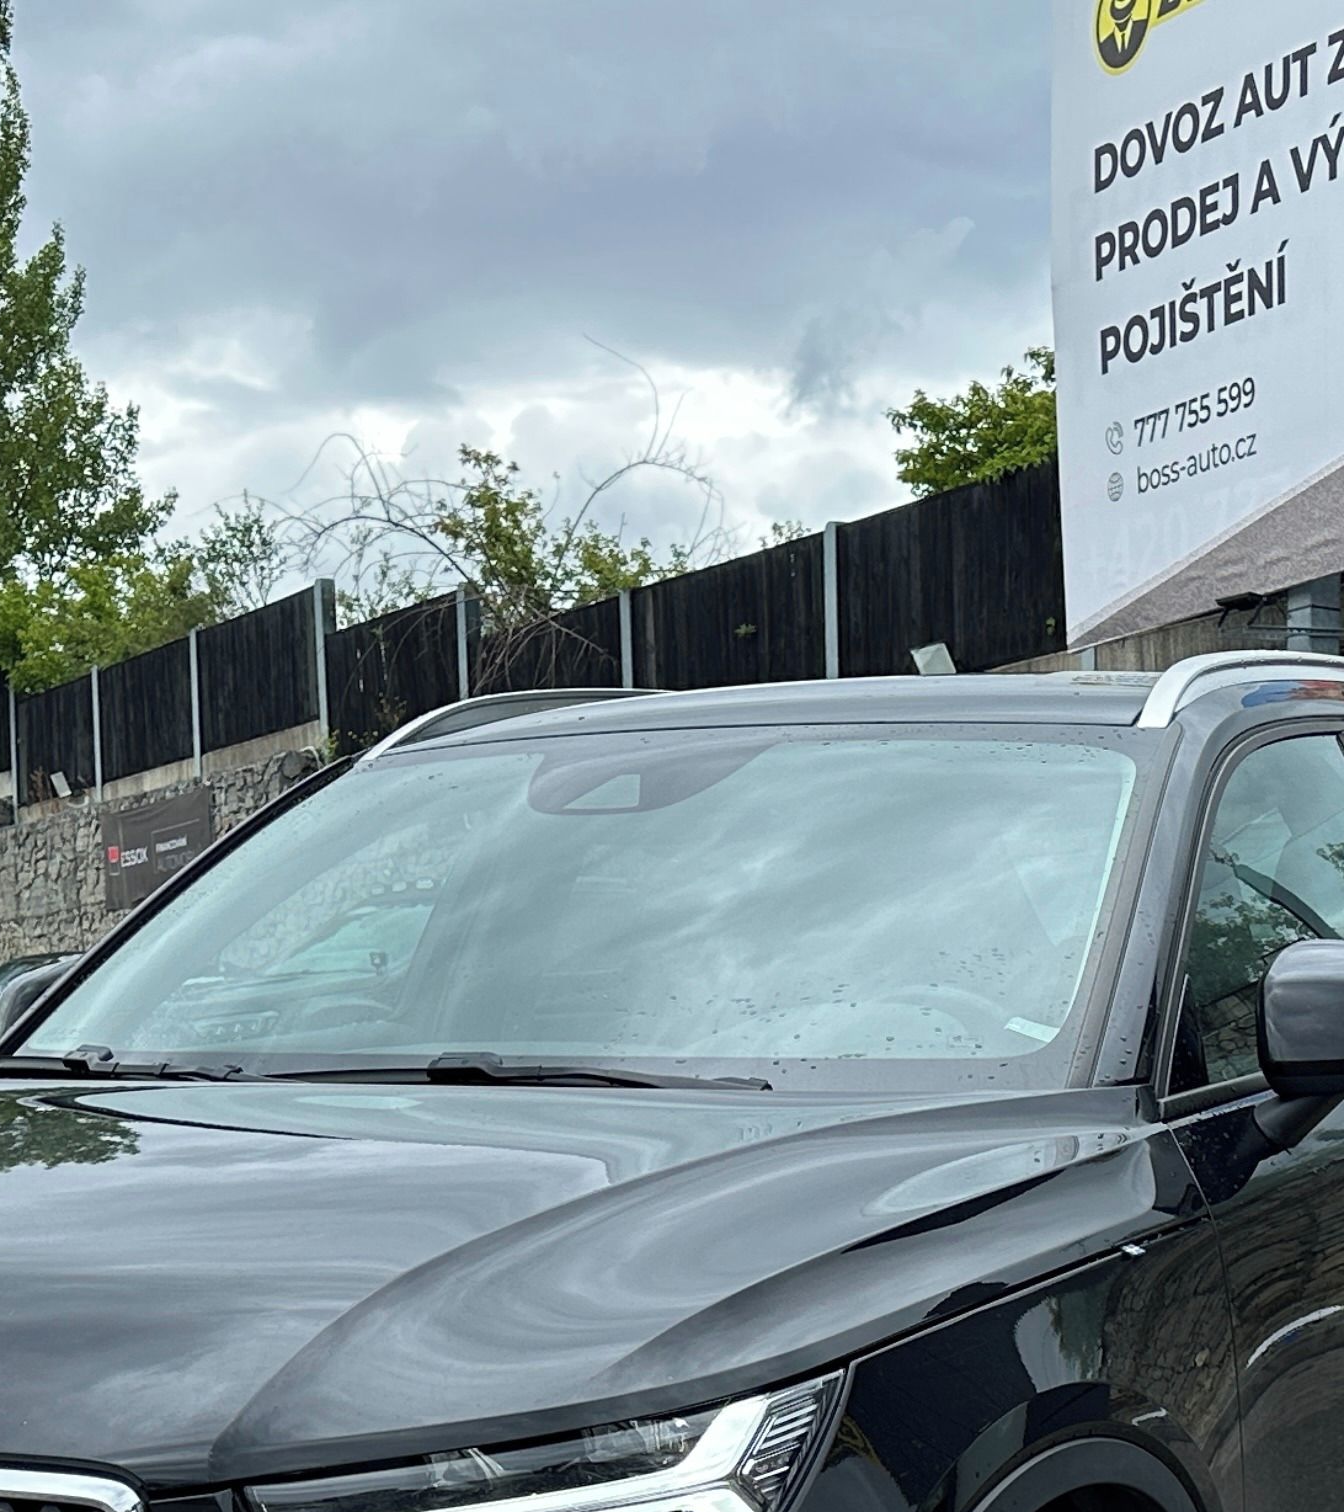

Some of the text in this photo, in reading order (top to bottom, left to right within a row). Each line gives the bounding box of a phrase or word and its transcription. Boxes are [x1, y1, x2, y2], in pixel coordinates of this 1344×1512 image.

[1094, 86, 1225, 193] DOVOZ
[1233, 42, 1317, 128] AUT
[1095, 173, 1239, 282] PRODEJ
[1250, 159, 1282, 215] A
[1100, 239, 1290, 375] POJIŠTĚNÍ
[1134, 377, 1256, 447] 777 755 599
[1137, 433, 1257, 494] boss-auto.cz
